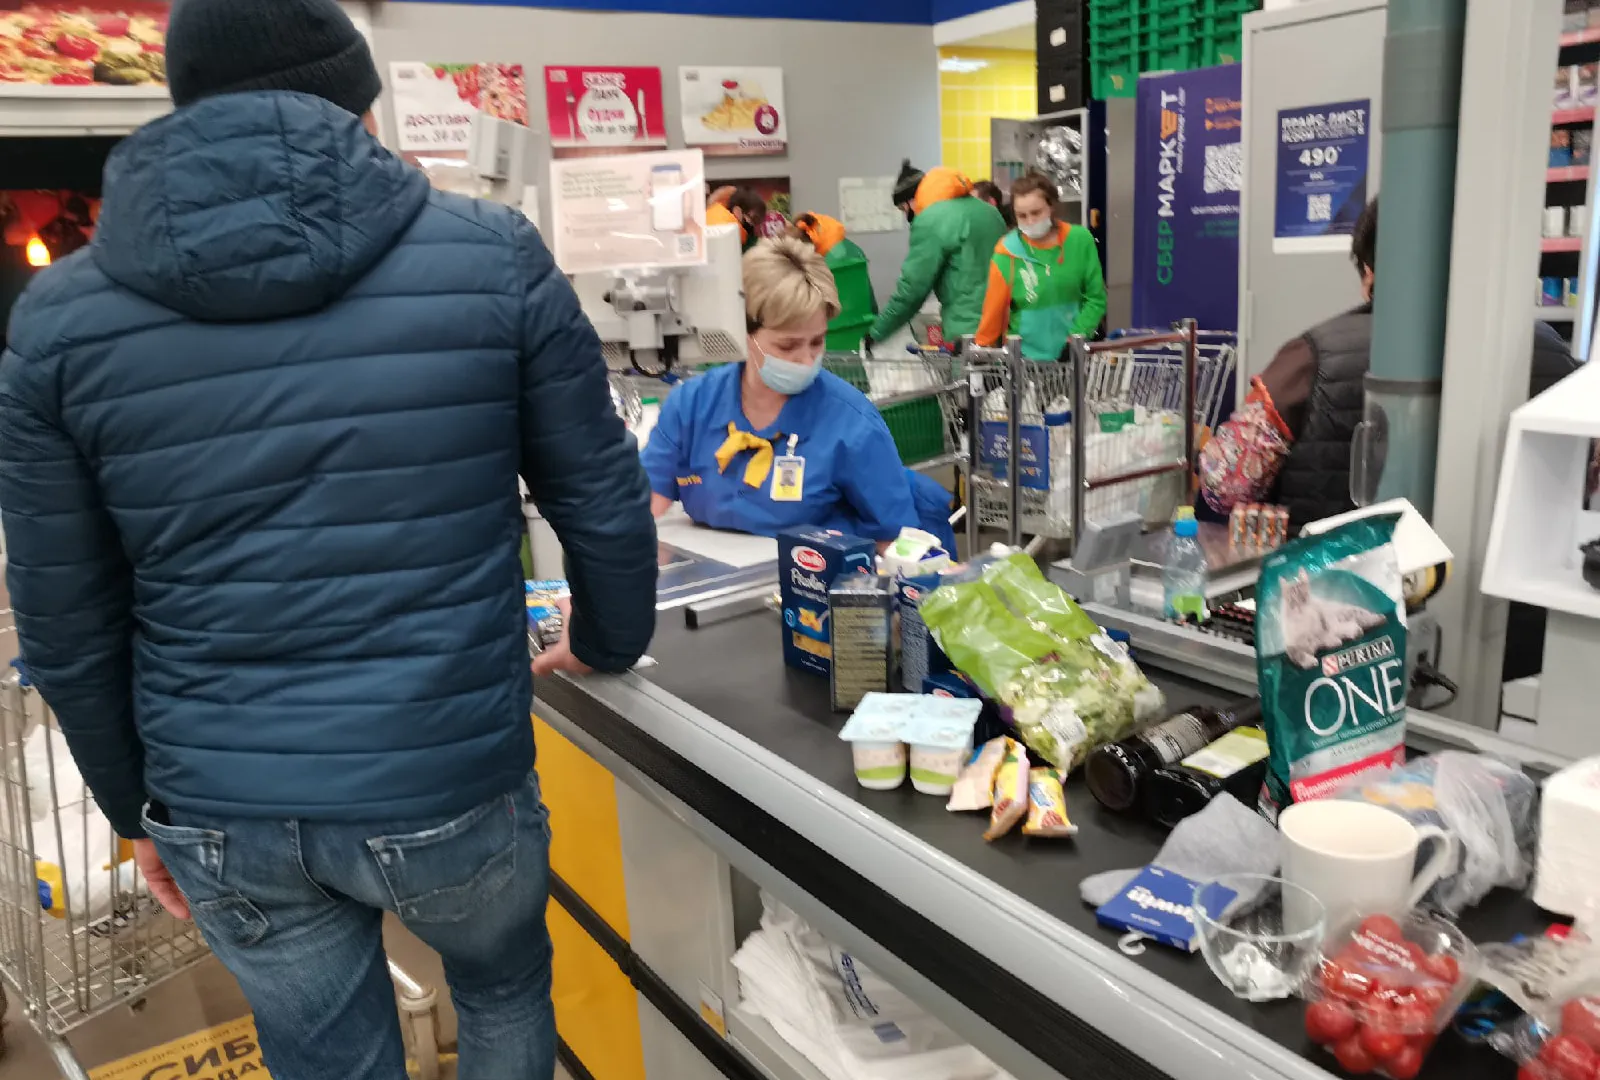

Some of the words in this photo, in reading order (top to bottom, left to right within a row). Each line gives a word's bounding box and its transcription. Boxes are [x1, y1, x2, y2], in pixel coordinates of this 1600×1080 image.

[1299, 146, 1338, 166] 490
[1338, 641, 1392, 669] PURINA
[1304, 658, 1405, 737] ONE
